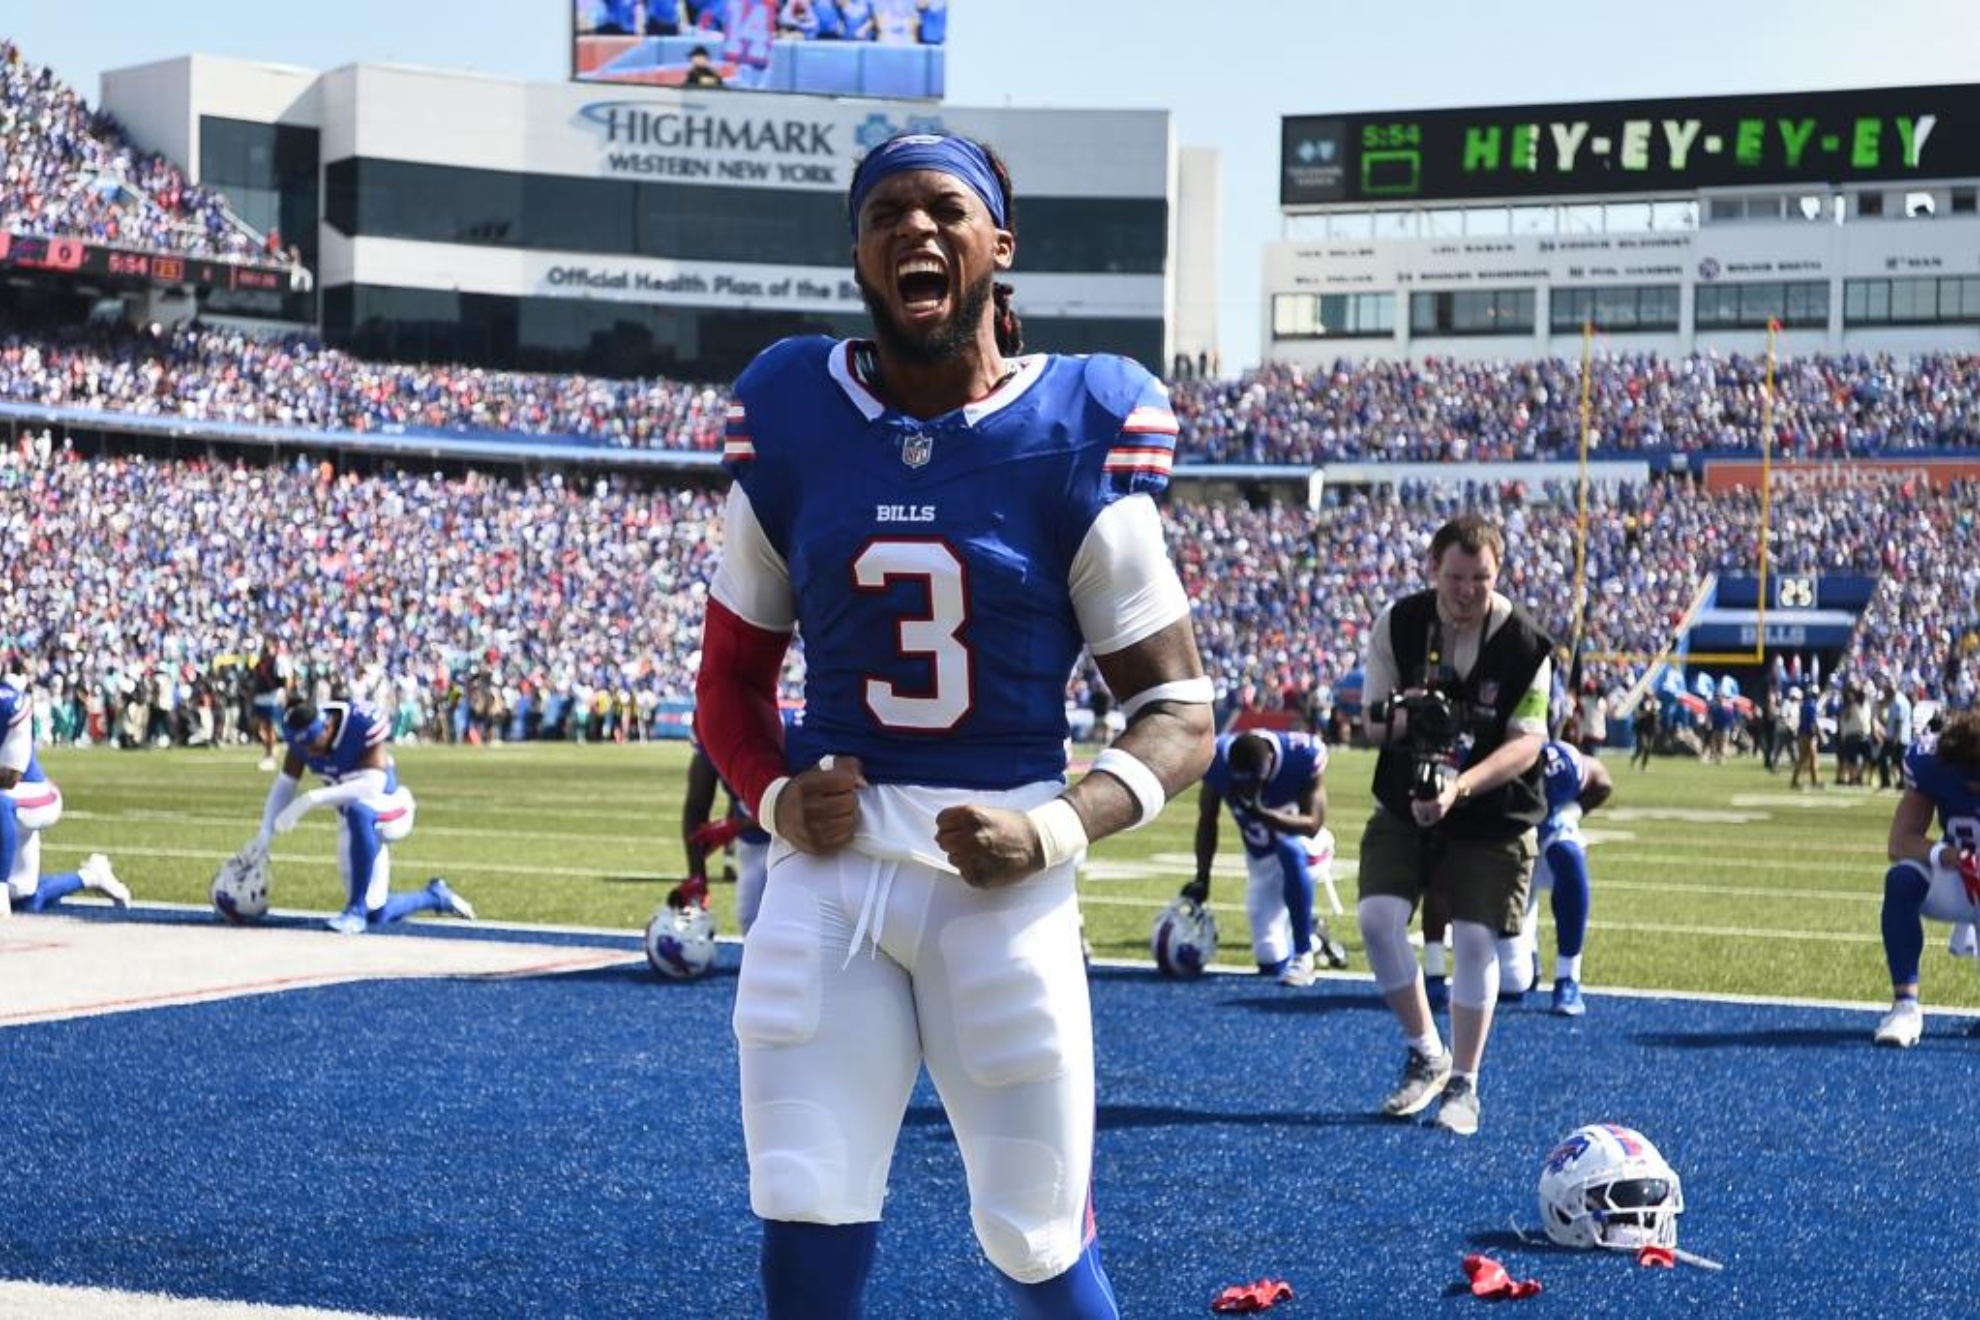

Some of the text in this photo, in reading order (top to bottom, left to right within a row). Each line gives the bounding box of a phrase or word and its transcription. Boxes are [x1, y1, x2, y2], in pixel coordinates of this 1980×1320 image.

[608, 108, 835, 156] HIGHMARK
[1362, 123, 1420, 148] 5:54
[608, 154, 836, 183] WESTERN NEW YORK
[547, 266, 628, 289] Official
[635, 270, 708, 293] Health
[713, 274, 762, 295] Plan
[768, 278, 790, 296] of
[797, 279, 830, 298] the
[876, 505, 936, 522] BILLS
[850, 537, 973, 732] 3
